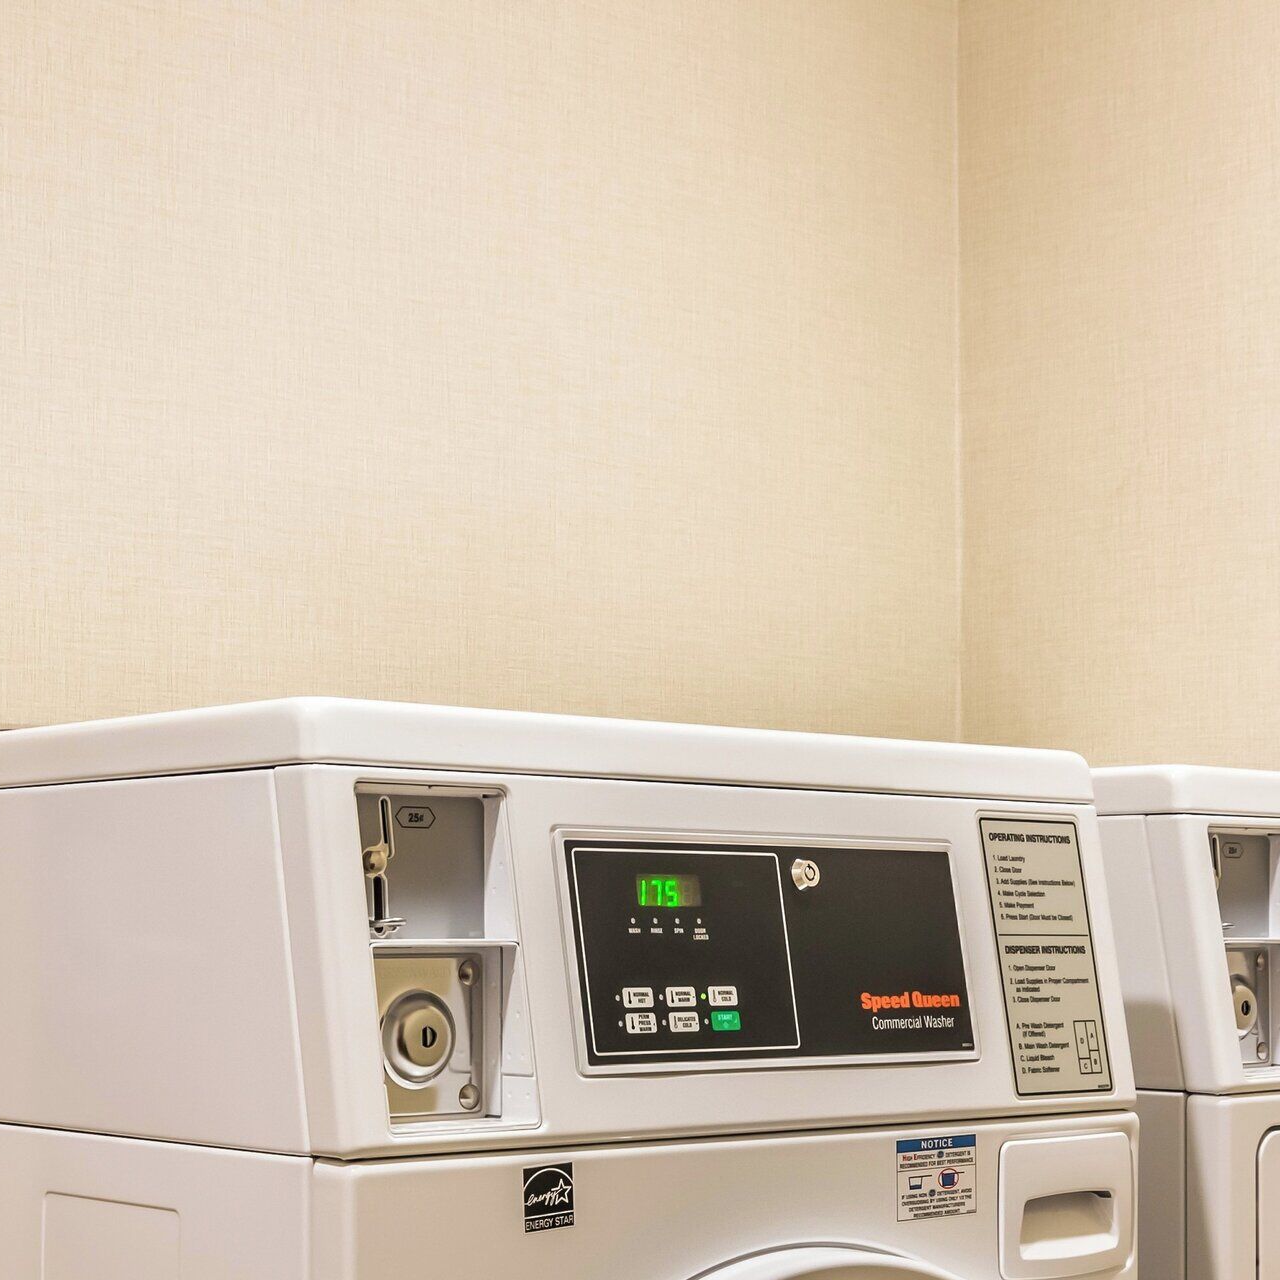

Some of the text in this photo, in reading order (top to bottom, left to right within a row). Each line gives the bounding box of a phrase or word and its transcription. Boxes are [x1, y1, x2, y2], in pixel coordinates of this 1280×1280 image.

[989, 832, 1071, 844] OPERATING INSTRUCTIONS
[1009, 855, 1025, 863] Laundry
[1015, 890, 1026, 899] Cycle
[1016, 902, 1034, 910] Payment
[1005, 945, 1086, 955] DISPENSER INSTRUCTIONS
[861, 991, 960, 1013] Speed Queen
[872, 1015, 954, 1030] Commercial Washer
[1043, 1022, 1064, 1030] Detergent
[921, 1138, 953, 1149] NOTICE
[526, 1215, 574, 1231] ENERGY STAR
